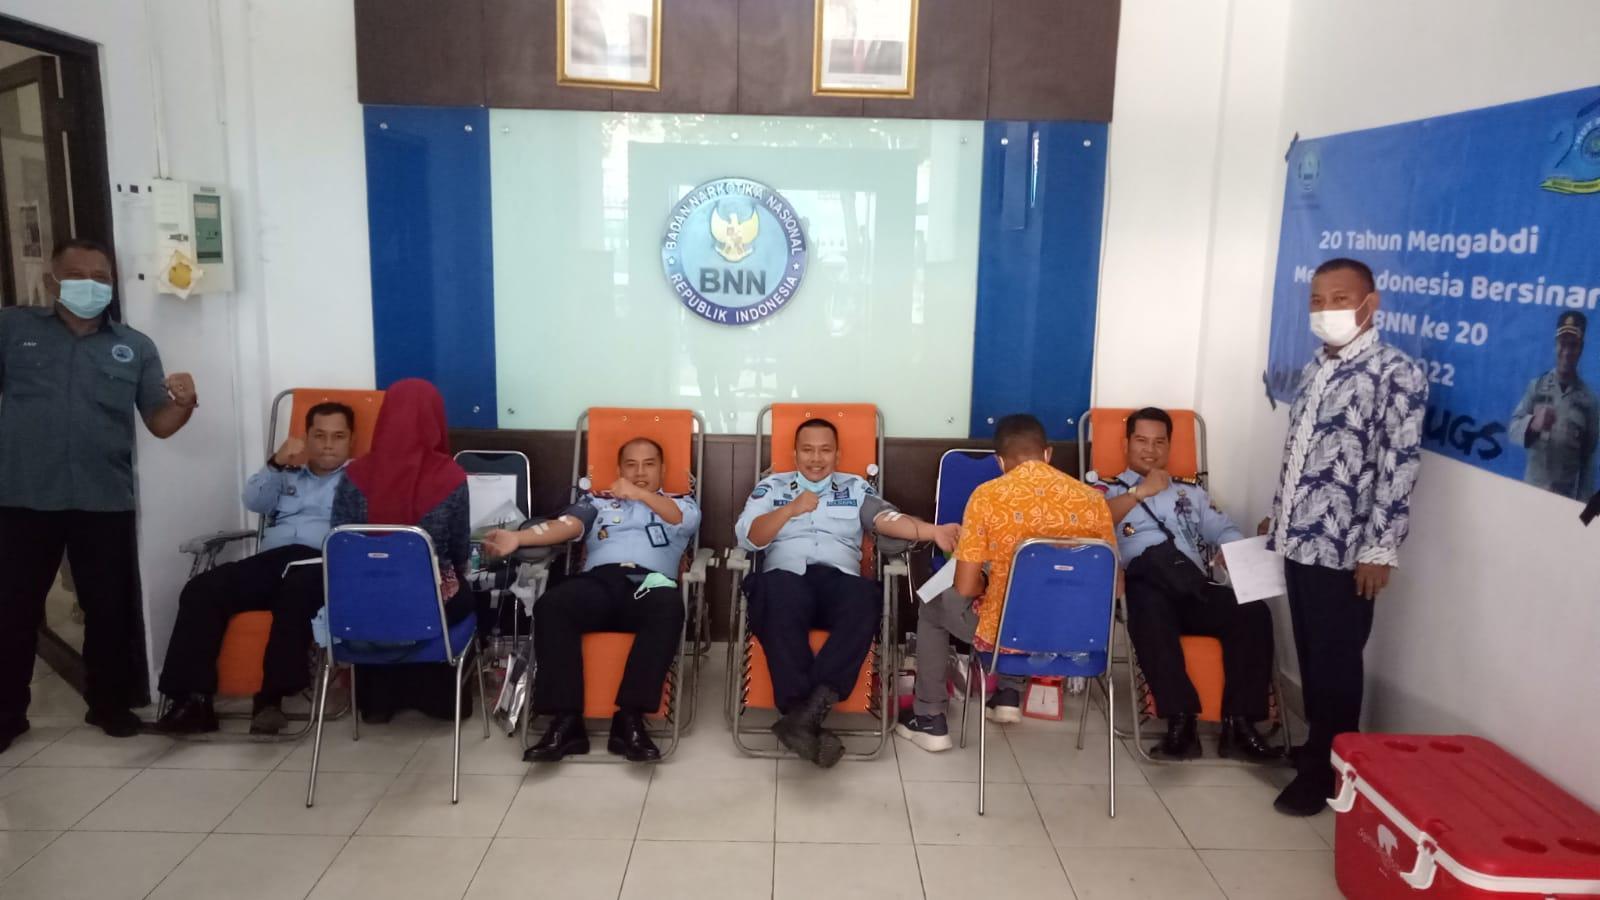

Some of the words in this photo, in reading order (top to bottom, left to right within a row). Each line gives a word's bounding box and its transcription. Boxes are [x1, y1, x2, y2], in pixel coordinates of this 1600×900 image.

[665, 206, 691, 249] BADAN
[689, 182, 763, 208] NARKOTIKA
[766, 195, 802, 256] NASIONAL
[1319, 231, 1342, 249] 20
[1346, 230, 1402, 251] Tahun
[1407, 225, 1539, 259] Mengabdi
[671, 273, 728, 322] REPUBLIK
[735, 276, 798, 323] INDONESIA
[700, 268, 766, 295] BNN
[1294, 265, 1315, 283] Me
[1376, 269, 1464, 298] donesia
[1471, 276, 1600, 310] Bersinar
[1373, 310, 1416, 335] BNN
[1421, 314, 1449, 340] ke
[1455, 321, 1488, 346] 20
[1416, 358, 1455, 387] 22
[1424, 405, 1507, 461] UGS
